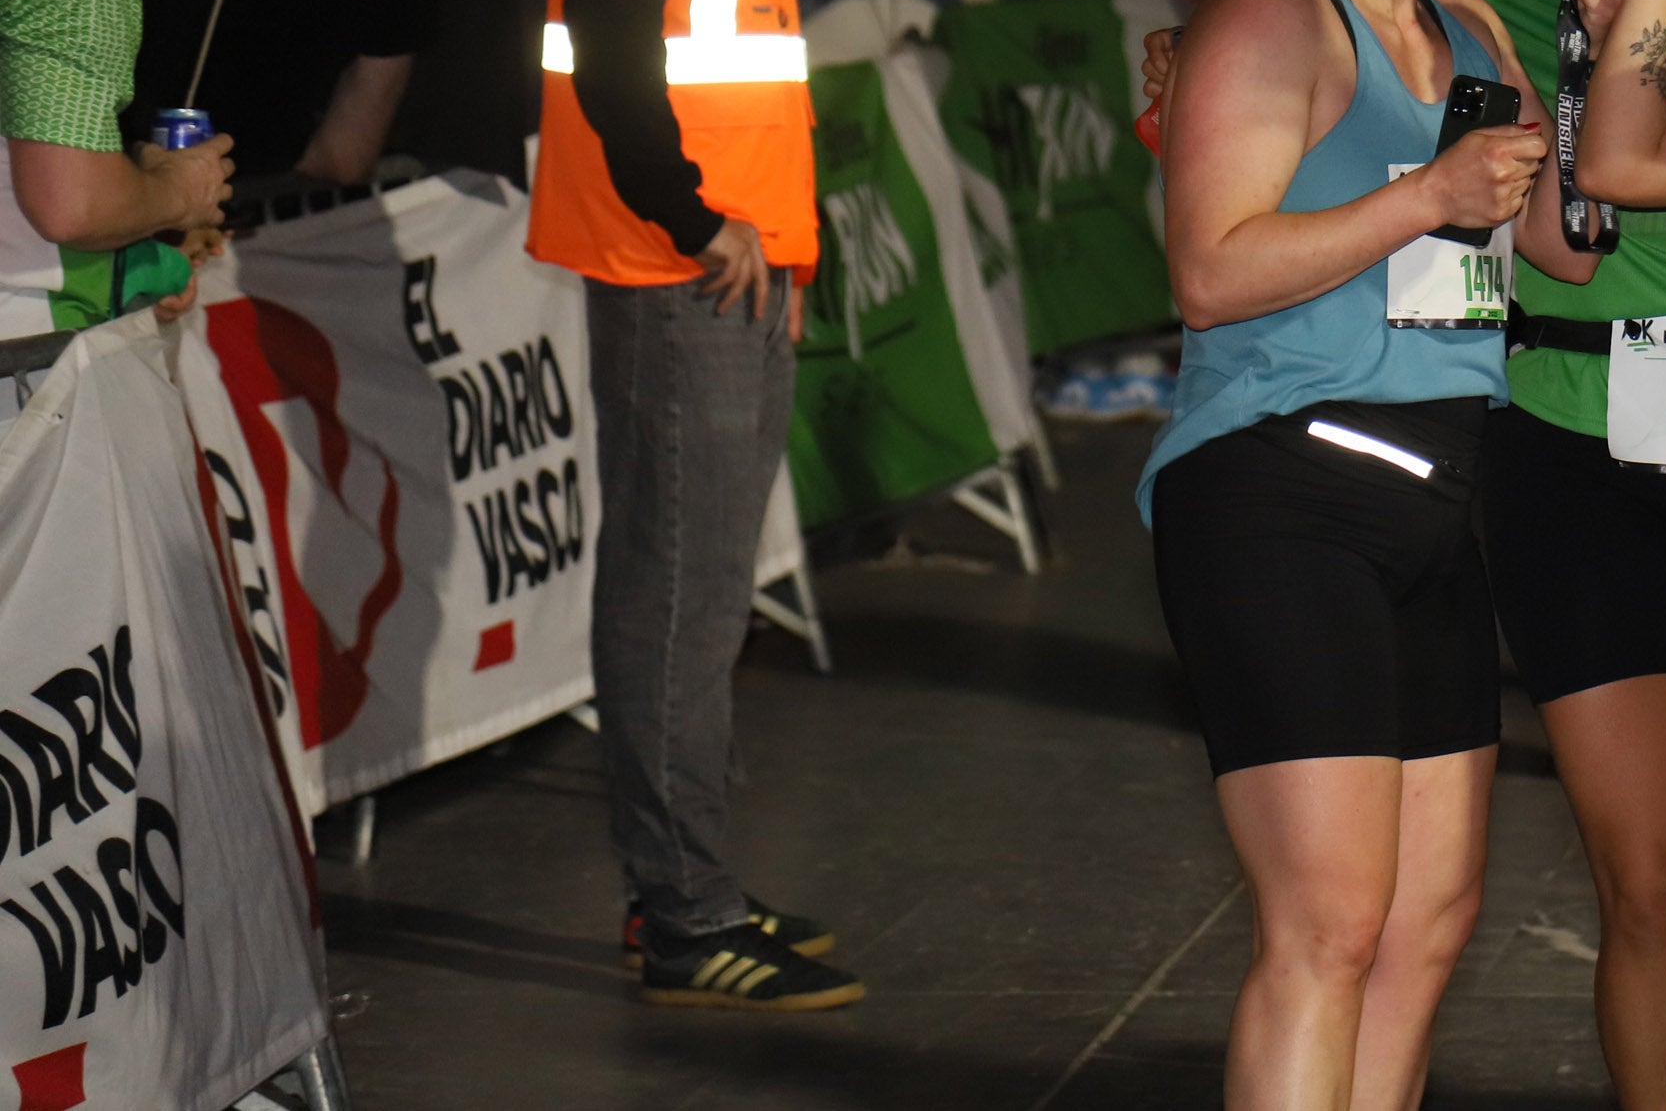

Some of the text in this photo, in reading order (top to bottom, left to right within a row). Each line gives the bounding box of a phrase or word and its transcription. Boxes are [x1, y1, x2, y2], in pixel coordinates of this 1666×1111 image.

[1558, 93, 1574, 170] FINISHER
[403, 256, 461, 364] EL
[1460, 255, 1504, 303] 1474
[440, 334, 573, 482] DIARIO
[466, 459, 583, 605] VASCO
